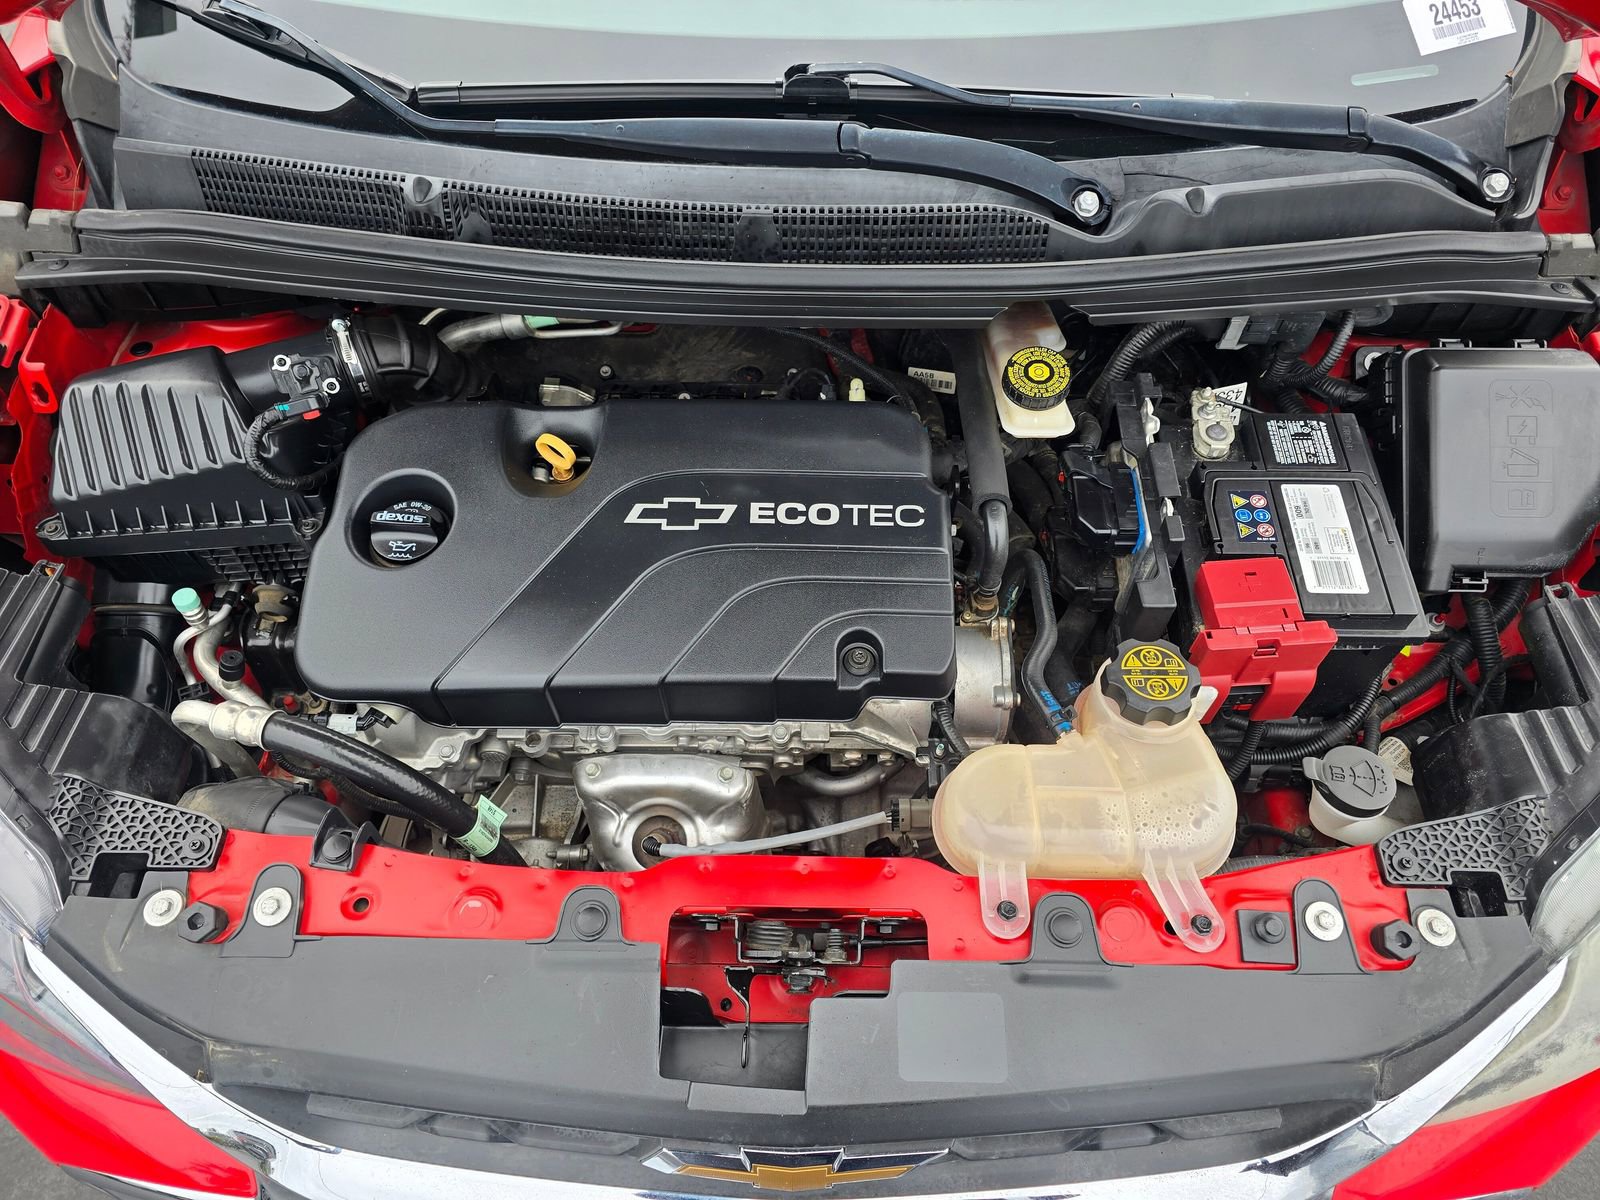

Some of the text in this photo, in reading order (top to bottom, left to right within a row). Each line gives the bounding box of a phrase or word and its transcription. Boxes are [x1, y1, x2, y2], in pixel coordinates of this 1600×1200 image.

[1429, 0, 1481, 25] 24453
[393, 501, 433, 512] SAE 0W-20
[1294, 505, 1304, 518] 600
[375, 511, 427, 523] dexos
[749, 502, 926, 528] ECOTEC
